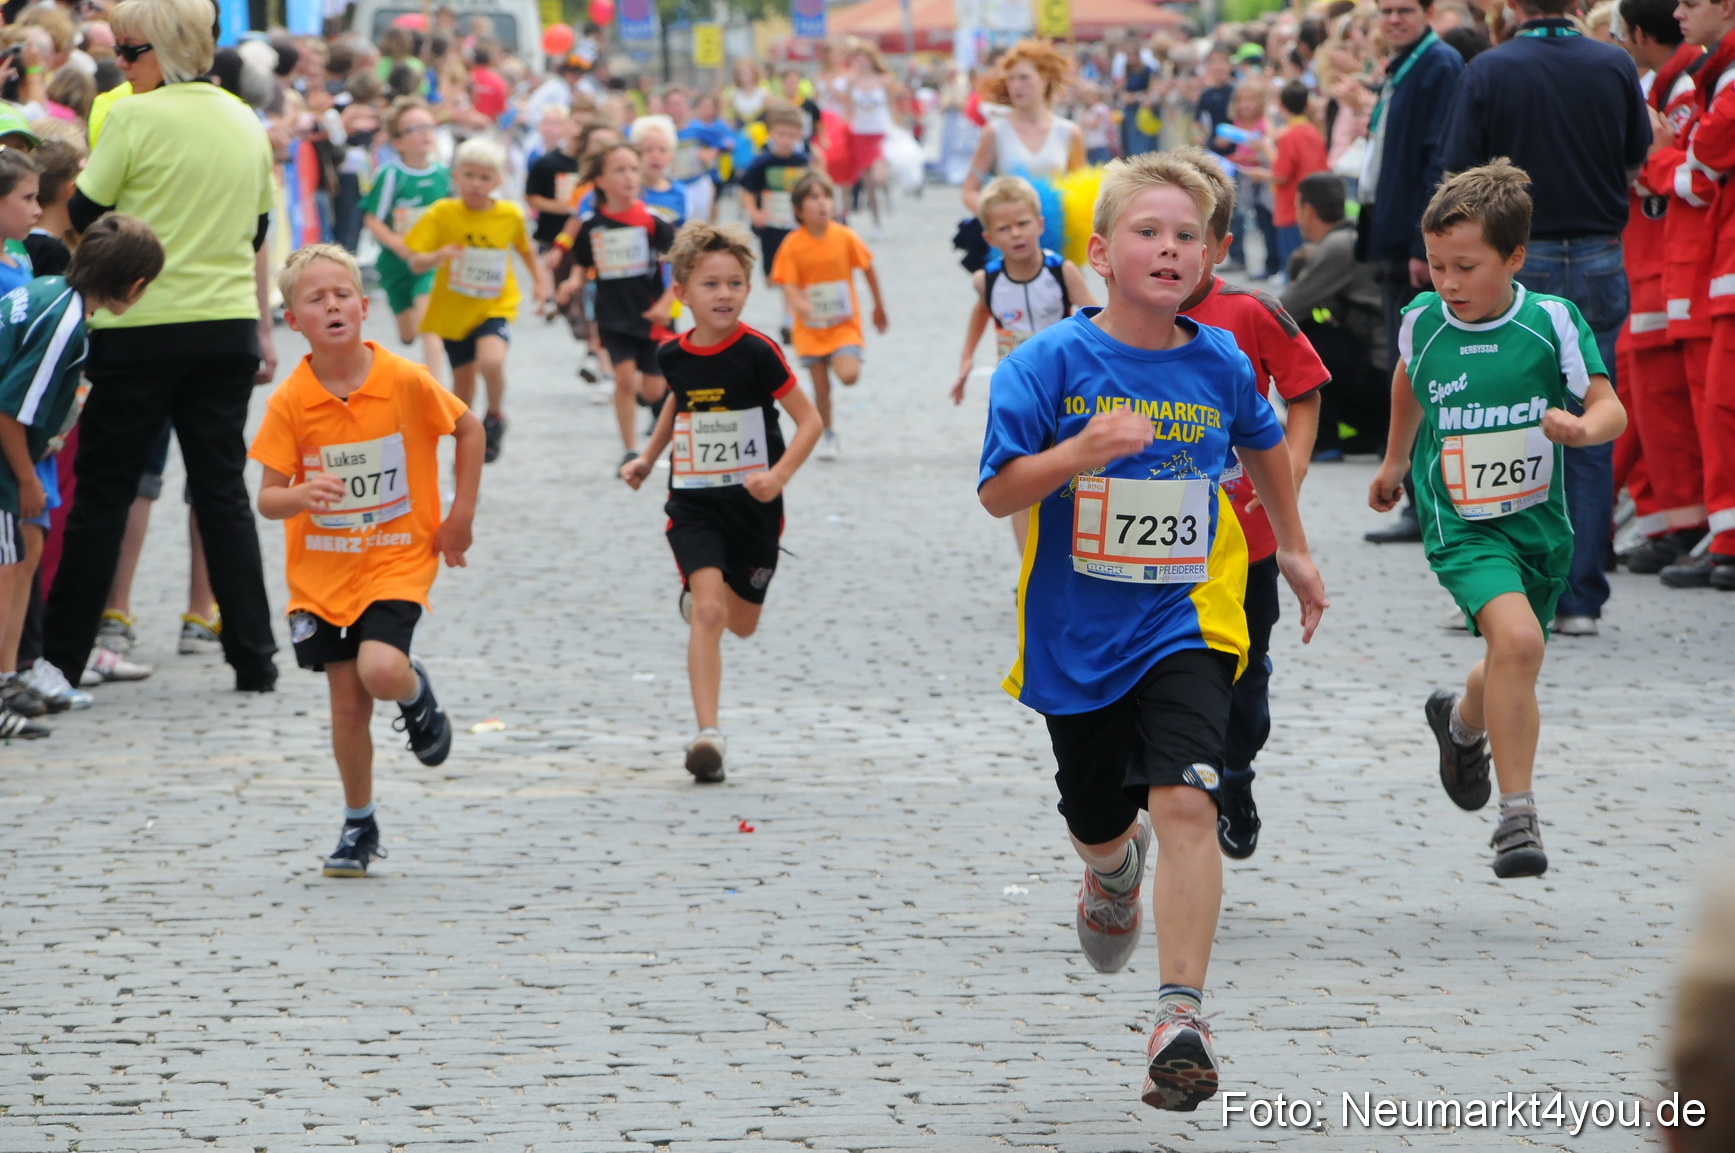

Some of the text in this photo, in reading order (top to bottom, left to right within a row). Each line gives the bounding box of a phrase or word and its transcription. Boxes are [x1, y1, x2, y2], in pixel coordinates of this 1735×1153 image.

[1459, 344, 1499, 355] DERBYSTAR
[1428, 372, 1469, 405] Sport
[1063, 395, 1091, 415] 10.
[1438, 395, 1549, 430] Münch
[695, 419, 738, 434] Joshua
[1151, 420, 1206, 444] LAUF
[325, 451, 367, 468] Lukas
[698, 438, 759, 463] 7214
[341, 467, 398, 498] 077
[1470, 455, 1543, 489] 7267
[305, 530, 412, 554] MERZ eisen
[1115, 513, 1198, 547] 7233
[1158, 564, 1205, 576] PFLEIDERER
